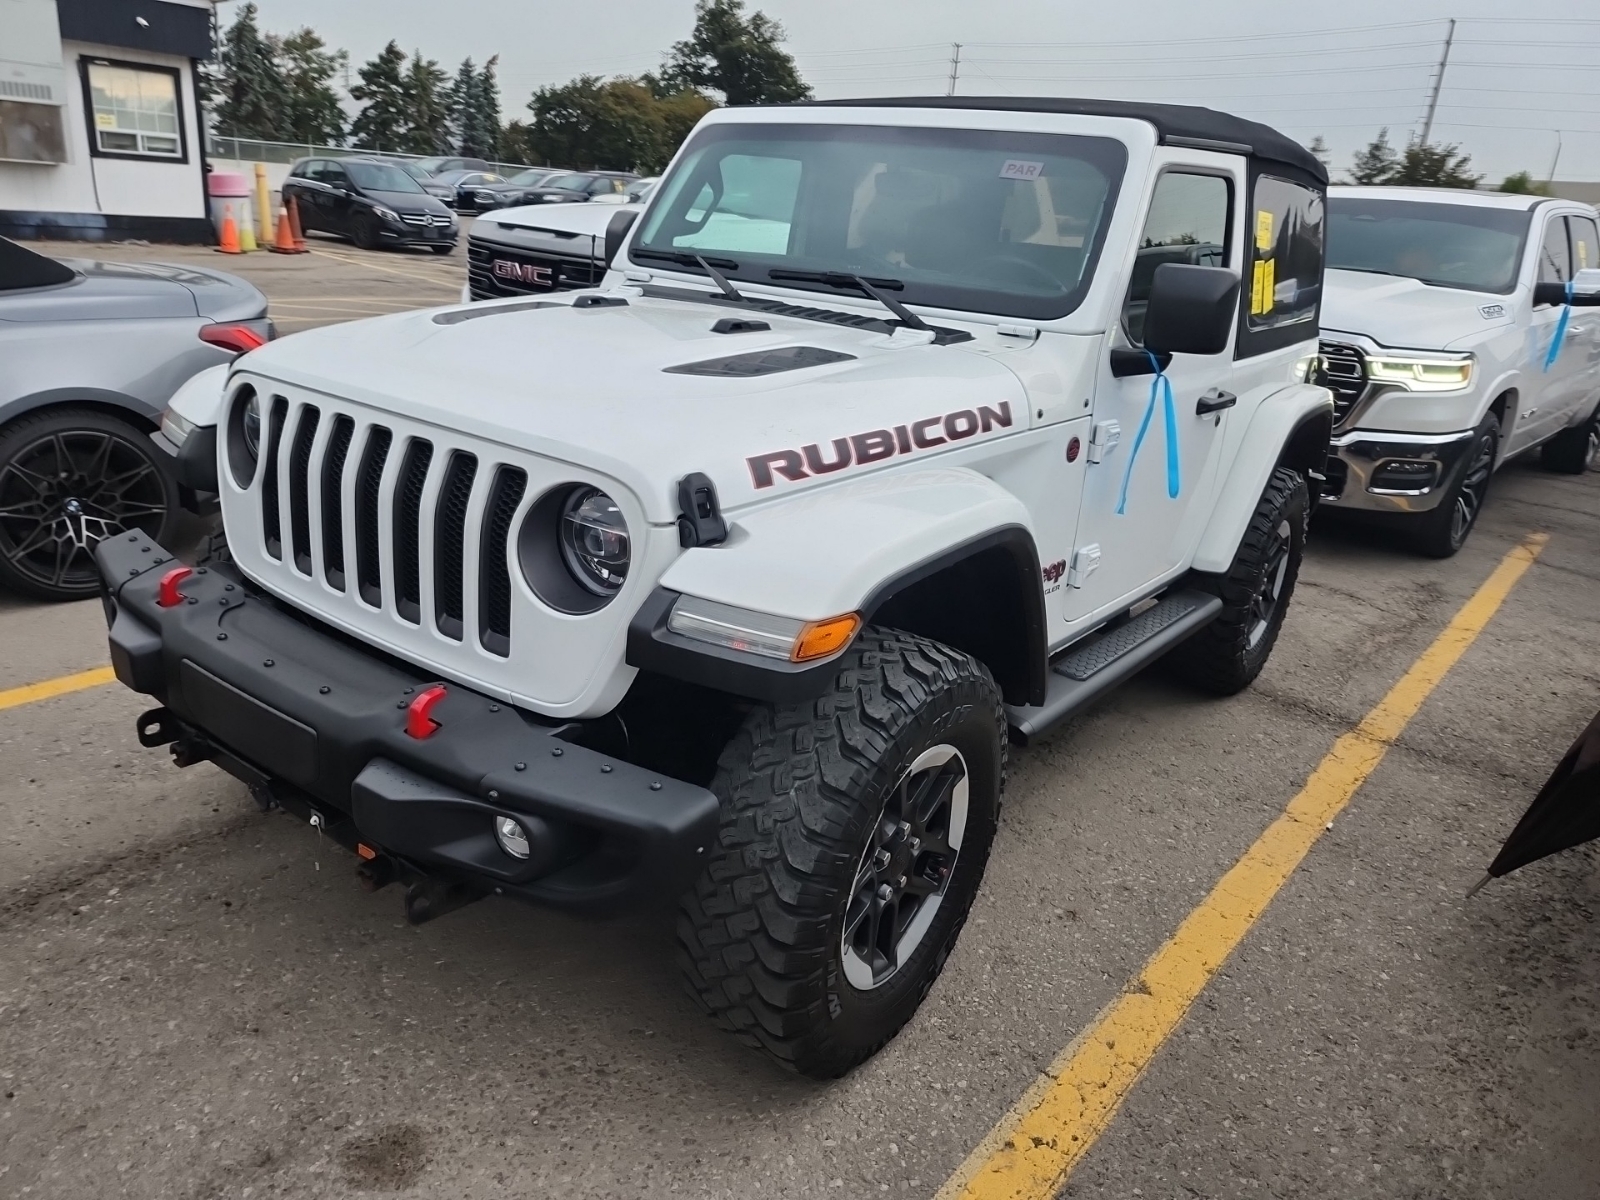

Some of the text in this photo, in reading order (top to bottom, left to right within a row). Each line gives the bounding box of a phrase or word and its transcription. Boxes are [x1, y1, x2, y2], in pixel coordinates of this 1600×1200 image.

[1005, 163, 1037, 176] PAR
[493, 259, 553, 287] GMC
[745, 400, 1013, 490] RUBICON
[1042, 558, 1067, 584] eep
[1044, 584, 1061, 596] GLER
